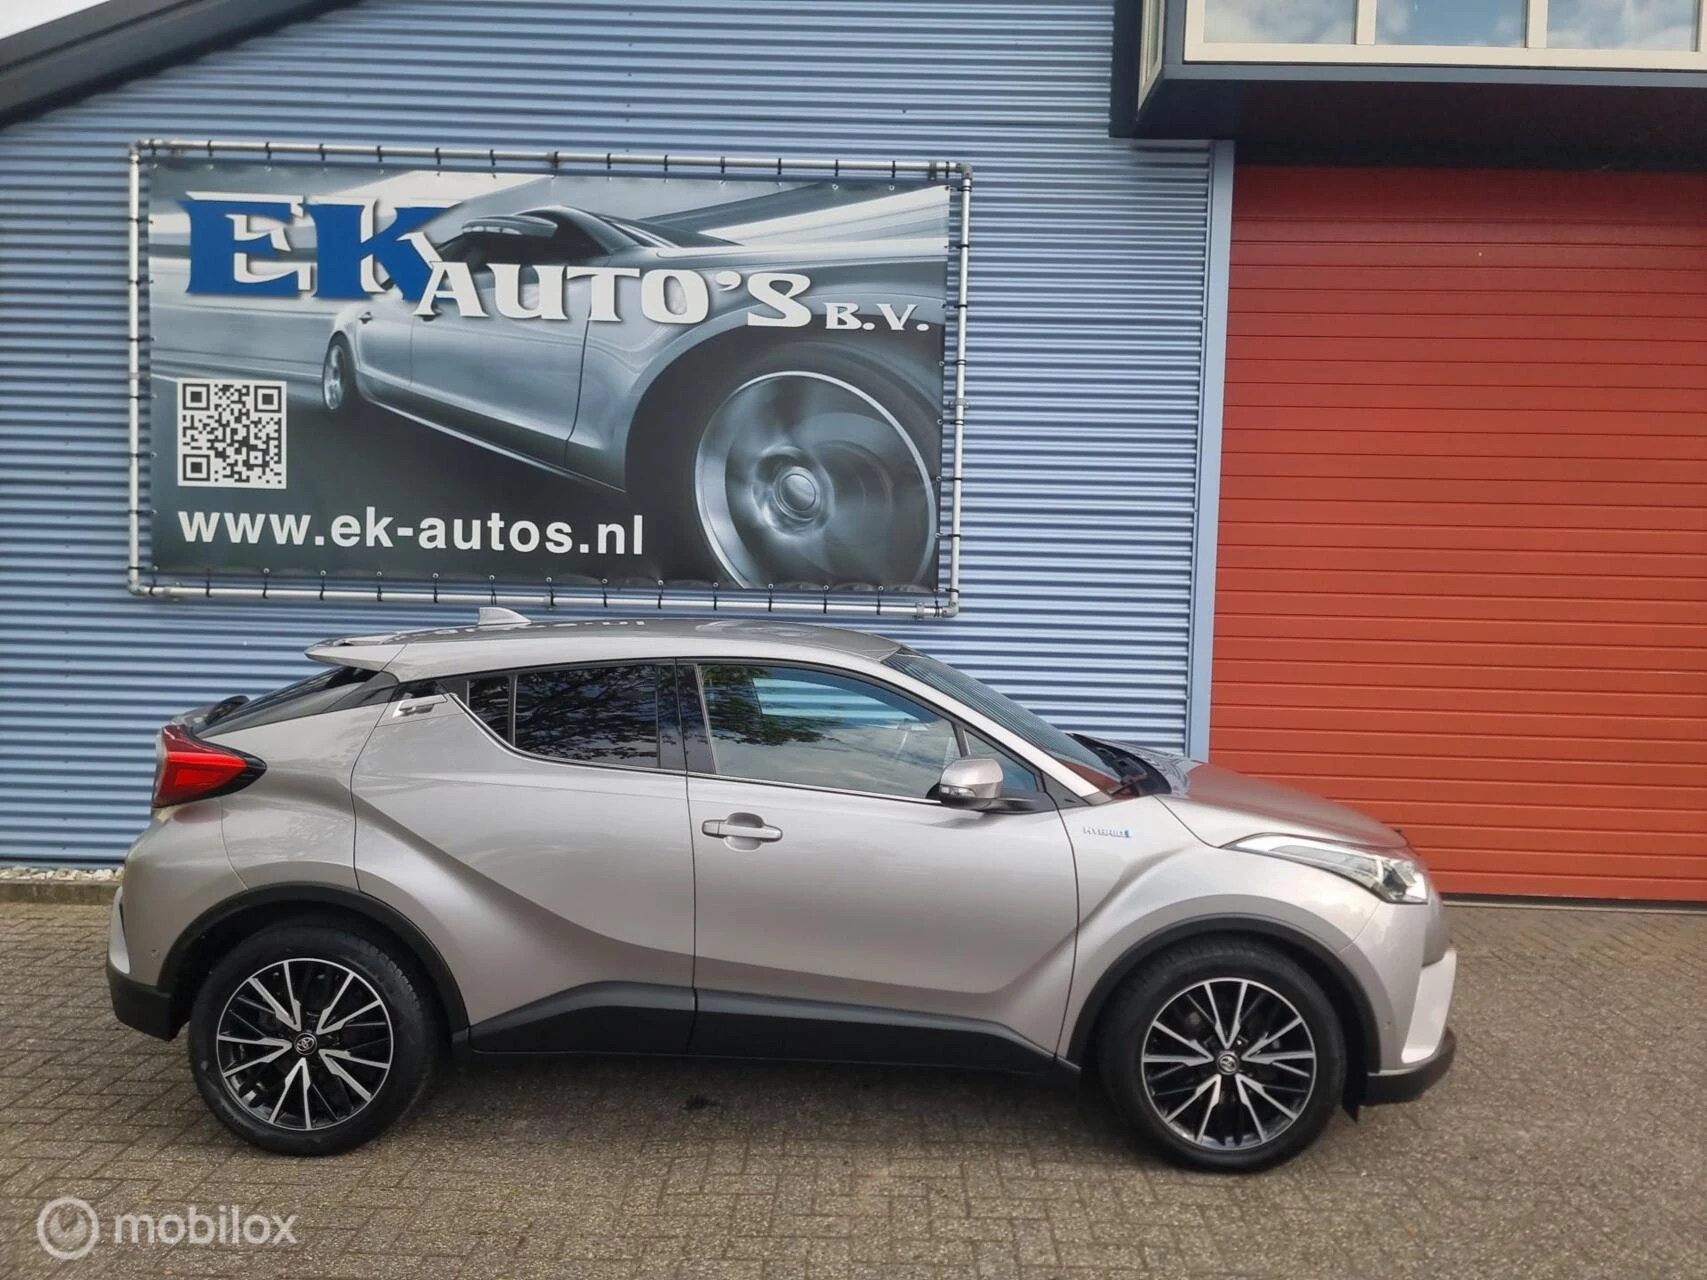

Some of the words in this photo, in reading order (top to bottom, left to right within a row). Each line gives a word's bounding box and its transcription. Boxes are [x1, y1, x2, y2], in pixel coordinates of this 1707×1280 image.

[181, 190, 462, 301] EK
[411, 260, 812, 328] AUTO'S
[822, 301, 931, 332] B.V.
[177, 505, 644, 556] www.ek-autos.nl
